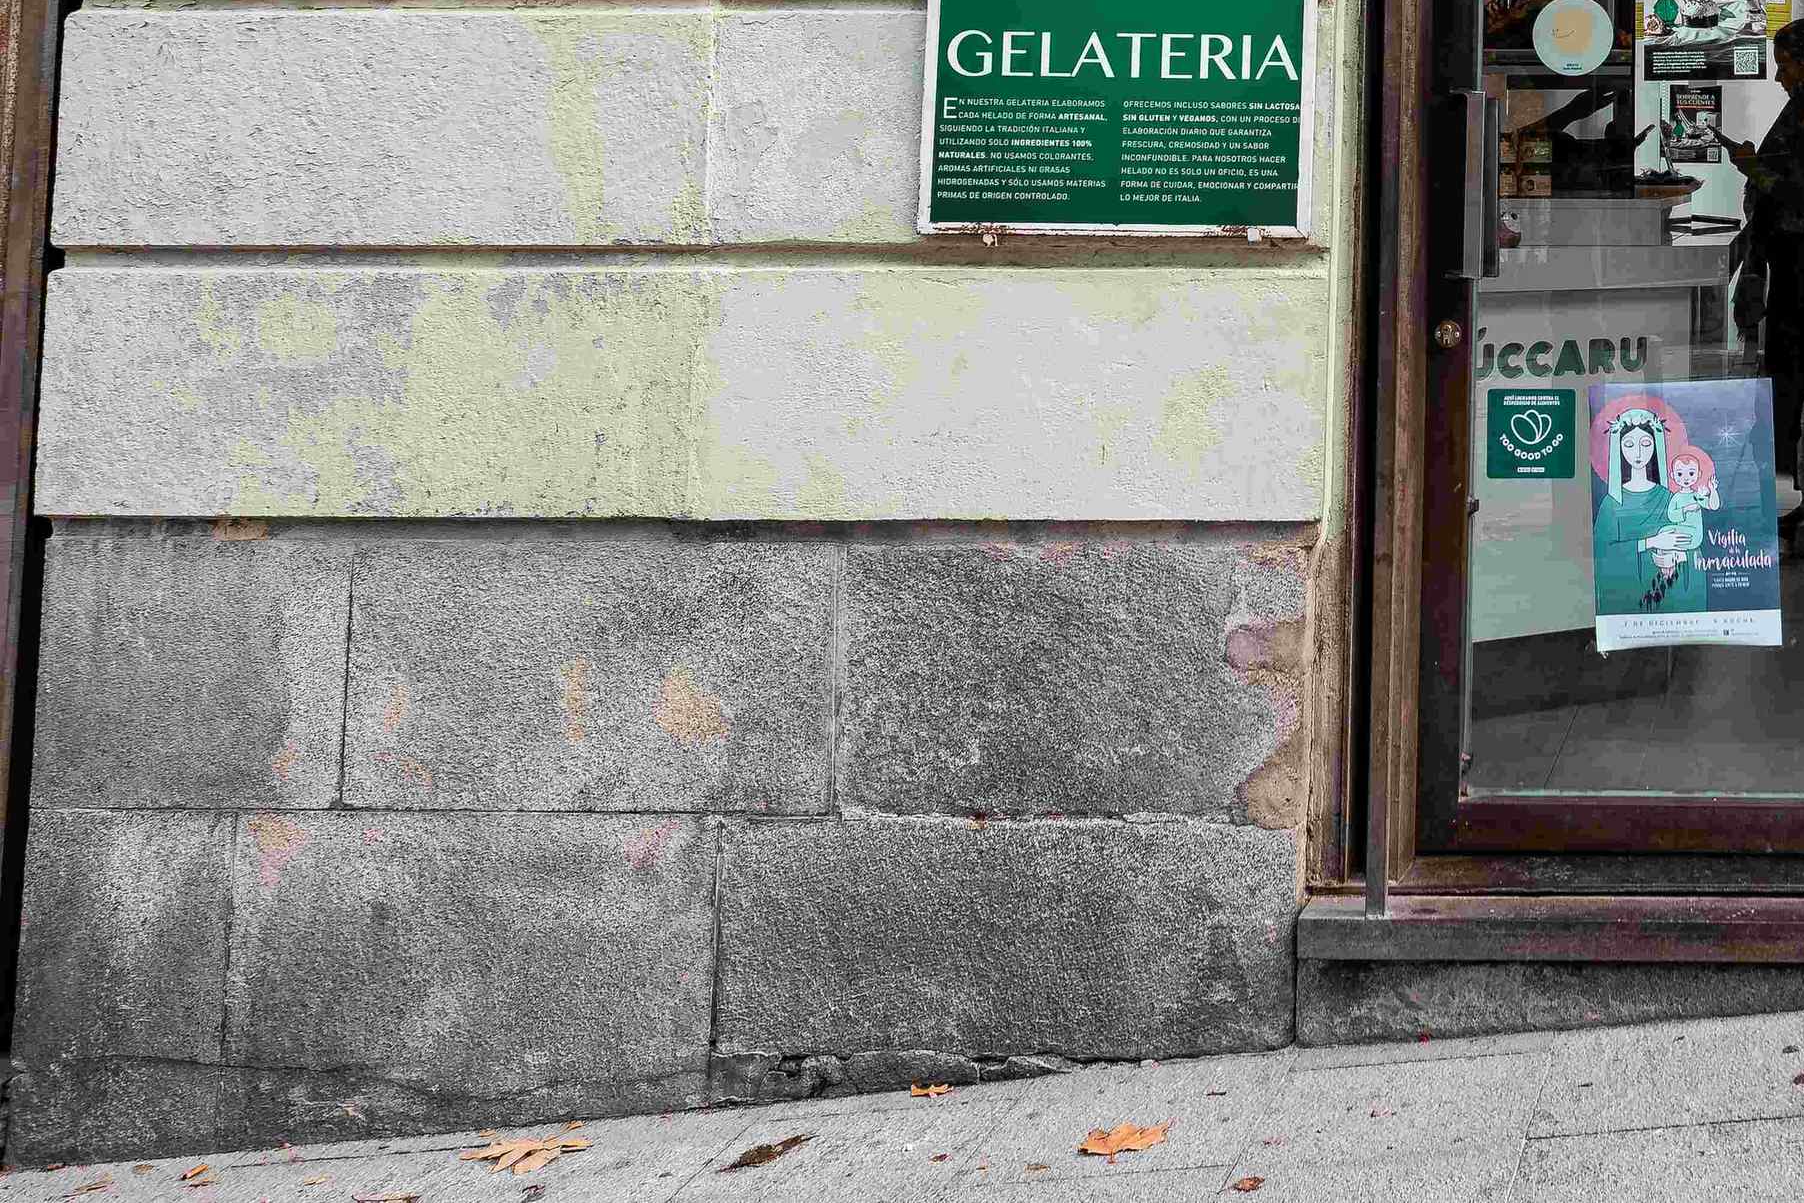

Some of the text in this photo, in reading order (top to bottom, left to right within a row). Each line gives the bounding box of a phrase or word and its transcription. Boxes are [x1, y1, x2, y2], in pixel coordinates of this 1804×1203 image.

[947, 29, 1299, 82] GELATERIA
[1005, 99, 1049, 107] GELATERIA
[1050, 99, 1106, 108] ELABORAMOS
[1123, 101, 1300, 110] OFRECEMOS INCLUSO SABORES SIN LACTOSA
[981, 112, 1013, 120] HELADO
[1014, 112, 1026, 120] DE
[1027, 112, 1056, 120] FORMA
[939, 124, 1086, 134] SIGUIENDO LA TRADICIÓN ITALIANA Y
[1179, 128, 1207, 136] DIARIO
[1226, 129, 1271, 137] GARANTIZA
[939, 138, 986, 146] UTILIZANDO
[1010, 139, 1070, 147] INGREDIENTES
[989, 152, 1002, 160] NO
[1003, 152, 1037, 160] USAMOS
[1190, 155, 1212, 163] PARA
[1214, 155, 1256, 163] NOSOTROS
[938, 165, 971, 173] AROMAS
[972, 165, 1026, 173] ARTIFICIALES
[1038, 166, 1071, 174] GRASAS
[937, 177, 1106, 188] HIDROGENADAS Y SÓLO USAMOS MATERIAS
[937, 191, 967, 199] PRIMAS
[981, 192, 1012, 200] ORIGEN
[1132, 194, 1159, 202] MEJOR
[1161, 194, 1172, 202] DE
[1499, 433, 1564, 461] TOO GOOD TO GO
[1708, 528, 1746, 549] Vigilia
[1693, 548, 1772, 571] Inmaculada
